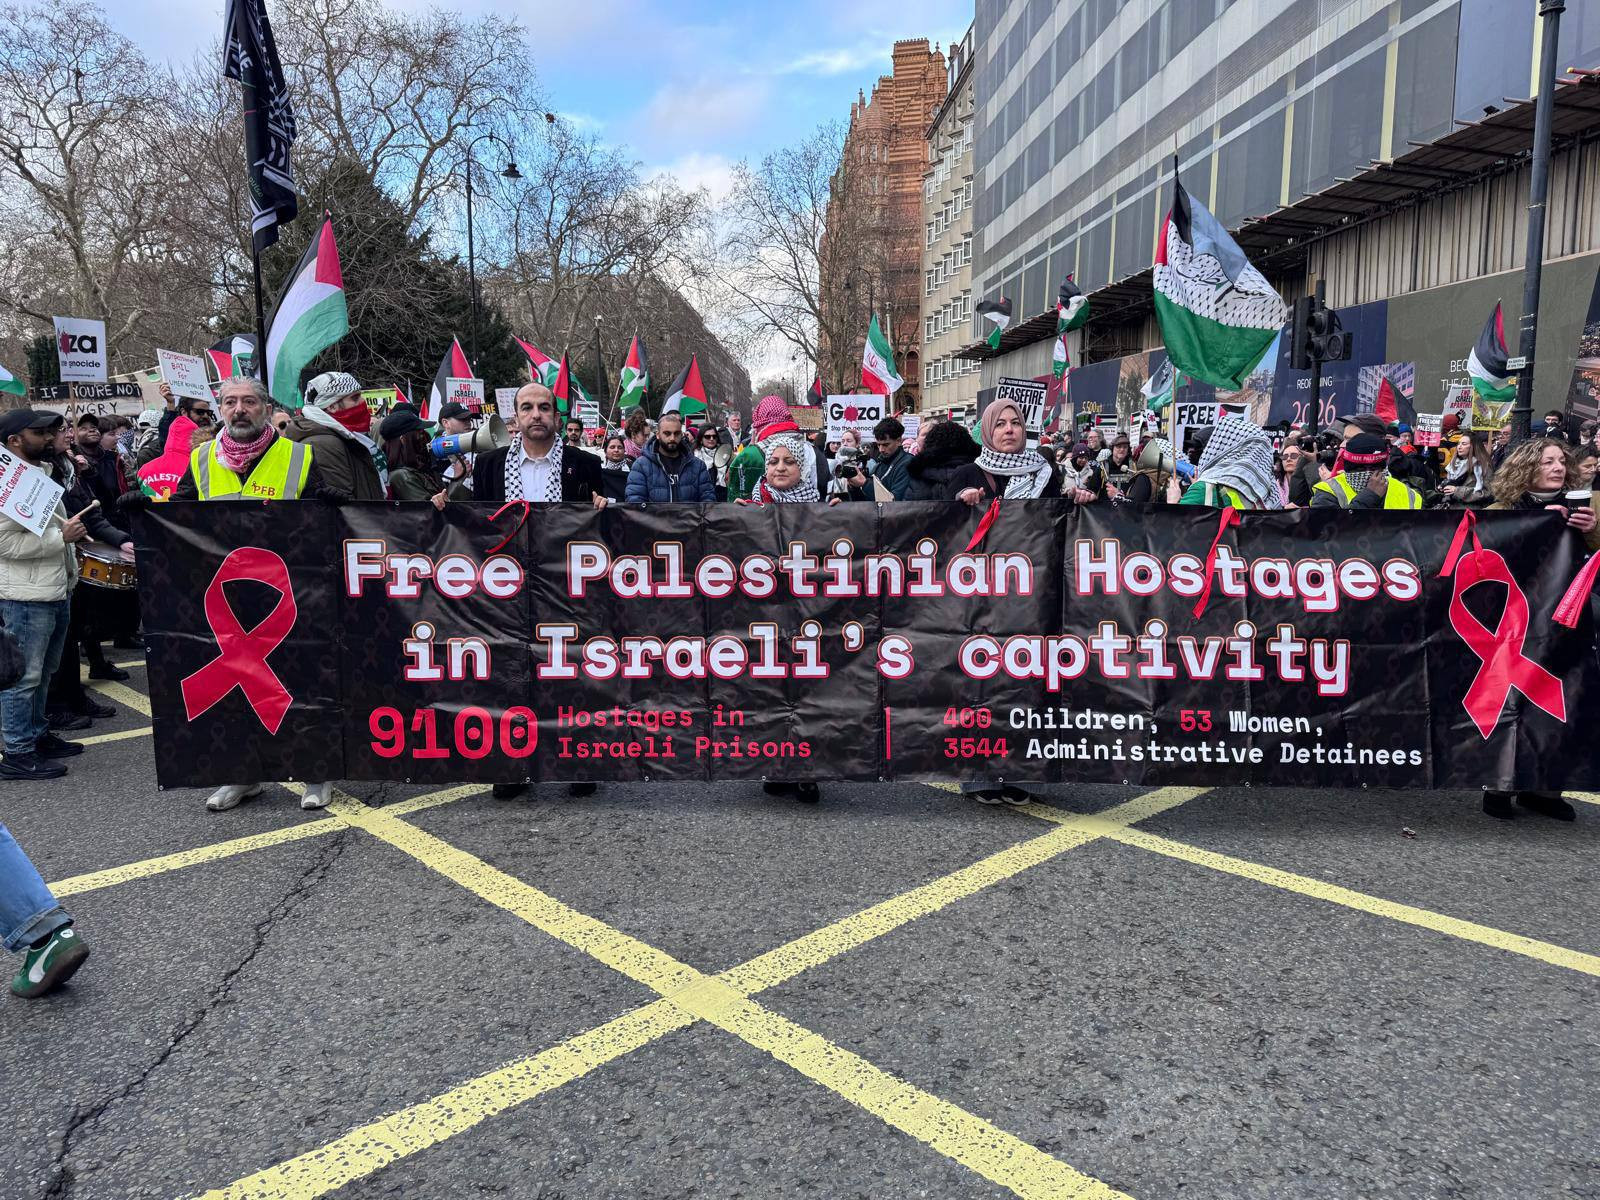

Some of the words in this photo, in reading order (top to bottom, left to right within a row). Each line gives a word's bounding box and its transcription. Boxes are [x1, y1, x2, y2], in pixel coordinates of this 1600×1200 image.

[40, 387, 58, 399] IF
[73, 384, 113, 397] YOU'RE
[116, 383, 141, 397] NOT
[459, 383, 471, 391] END
[1296, 376, 1333, 390] REOPING
[454, 390, 477, 398] ISRAELI
[998, 386, 1044, 406] CEASEFIRE
[65, 402, 117, 416] ANGRY
[481, 403, 496, 414] THE
[830, 402, 880, 421] Gza
[1176, 404, 1215, 425] FREE
[1291, 392, 1336, 426] 2026
[142, 473, 181, 487] PALESTI
[253, 485, 275, 496] PFB
[343, 539, 525, 598] Free
[567, 538, 1033, 598] Palestinian
[1075, 538, 1422, 612] Hostages
[403, 621, 491, 680] in
[536, 620, 914, 680] Israeli's
[958, 618, 1350, 696] captivity
[558, 705, 693, 731] Hostages
[713, 704, 745, 726] in
[943, 707, 992, 729] 400
[1009, 706, 1158, 734] Children,
[1180, 709, 1213, 732] 53
[1229, 709, 1322, 736] Women,
[368, 706, 538, 759] 9100
[558, 736, 676, 758] Israeli
[695, 735, 811, 758] Prisons
[943, 737, 1009, 759] 3544
[1026, 738, 1263, 764] Administrative
[1280, 741, 1422, 765] Detainees
